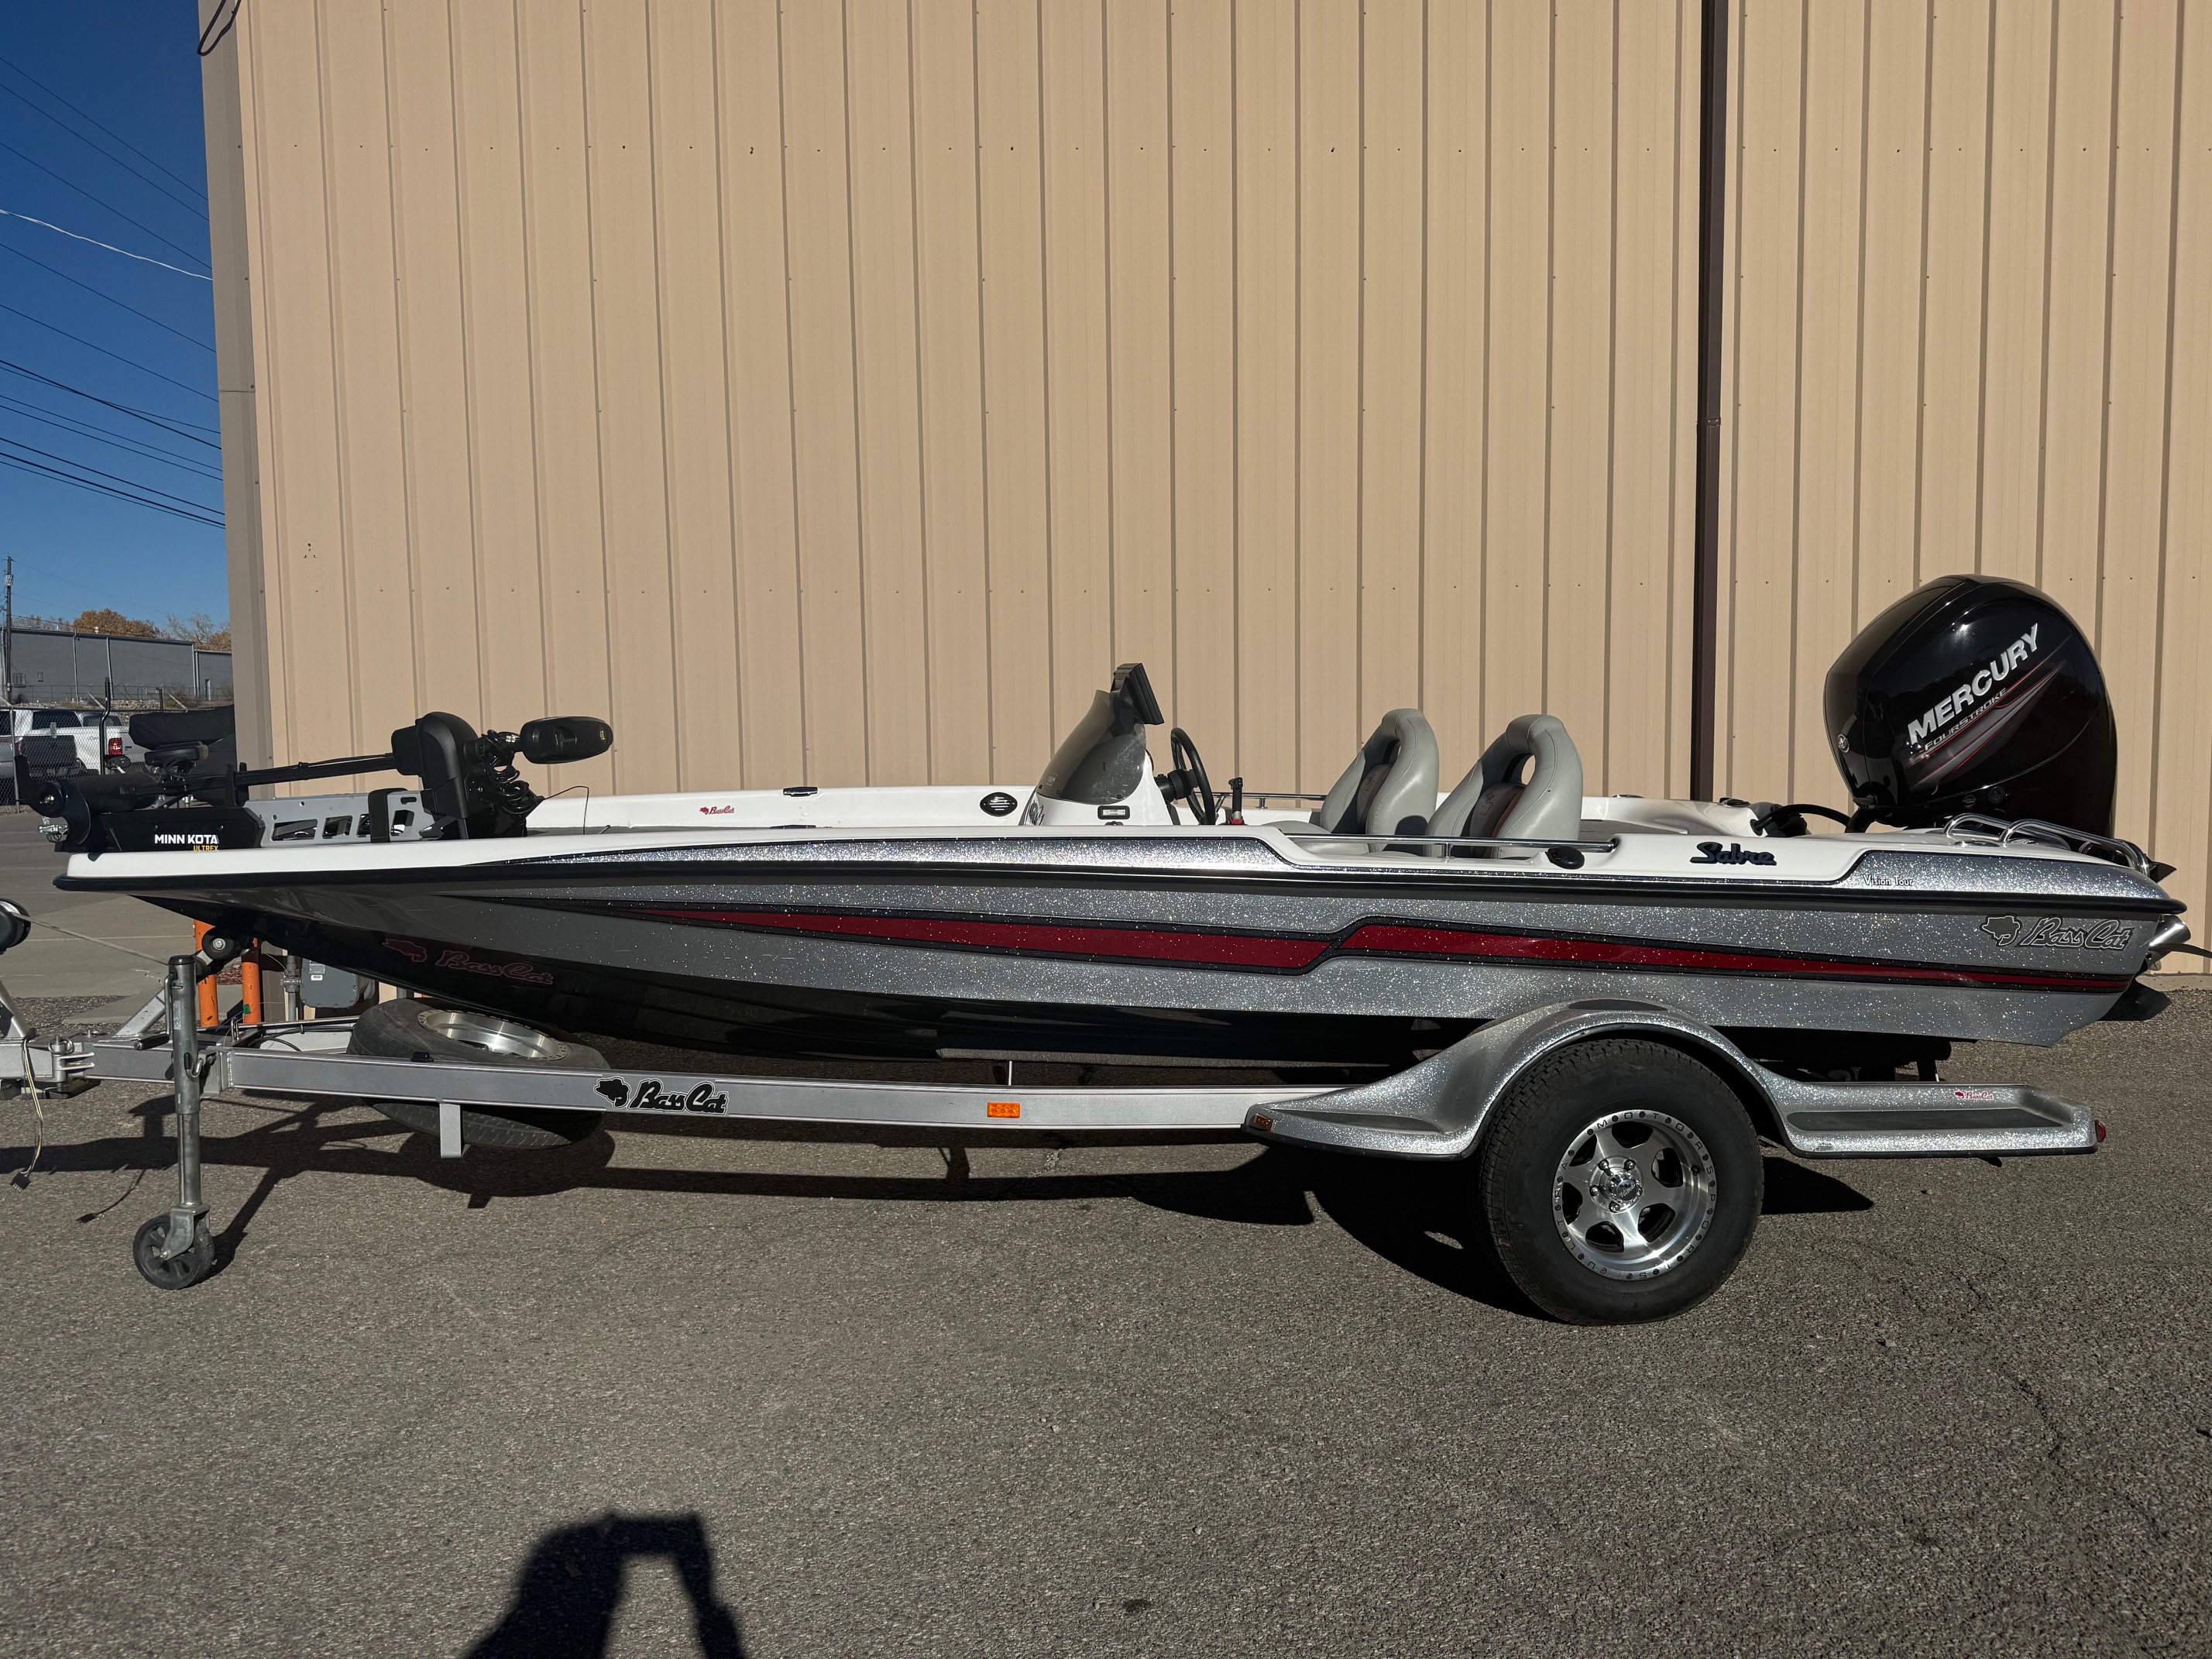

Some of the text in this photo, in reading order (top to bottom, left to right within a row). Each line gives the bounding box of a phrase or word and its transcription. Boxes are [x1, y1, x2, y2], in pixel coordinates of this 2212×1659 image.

[1907, 622, 2039, 746] MERCURY
[1924, 687, 2008, 751] FOURSTROKE
[154, 834, 218, 844] MINN KOTA
[1689, 841, 1778, 866] Sabre
[1862, 874, 1913, 886] Vision Tour
